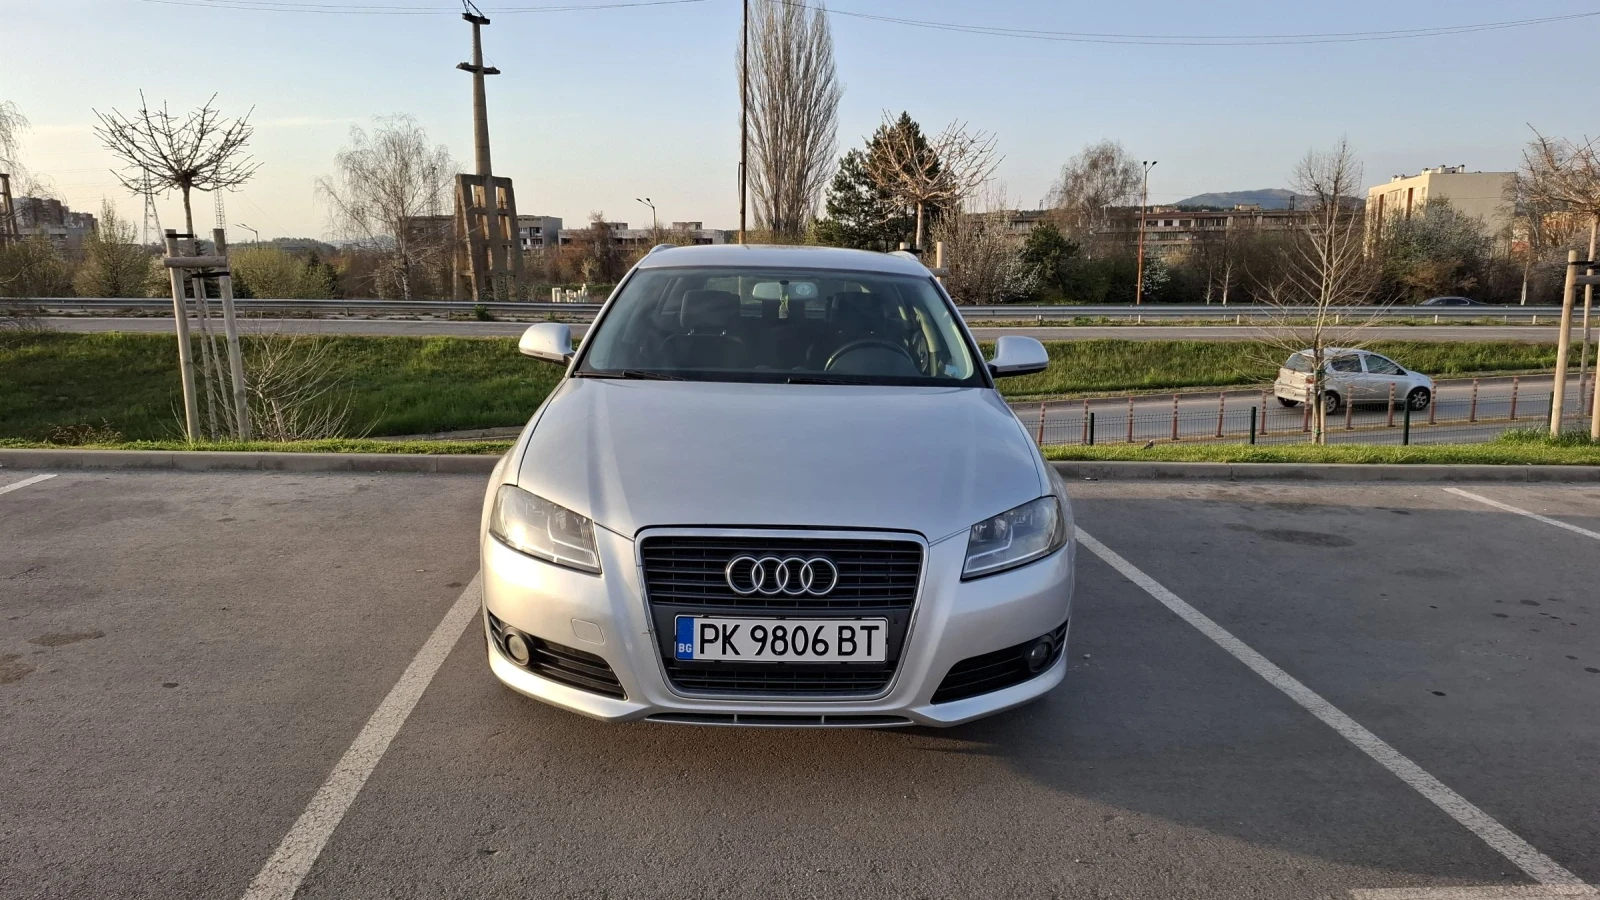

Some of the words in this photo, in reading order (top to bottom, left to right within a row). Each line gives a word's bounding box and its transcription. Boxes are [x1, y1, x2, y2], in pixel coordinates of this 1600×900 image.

[678, 643, 692, 653] BG
[699, 623, 741, 656] PK
[750, 624, 829, 657] 9806
[837, 625, 880, 657] BT
